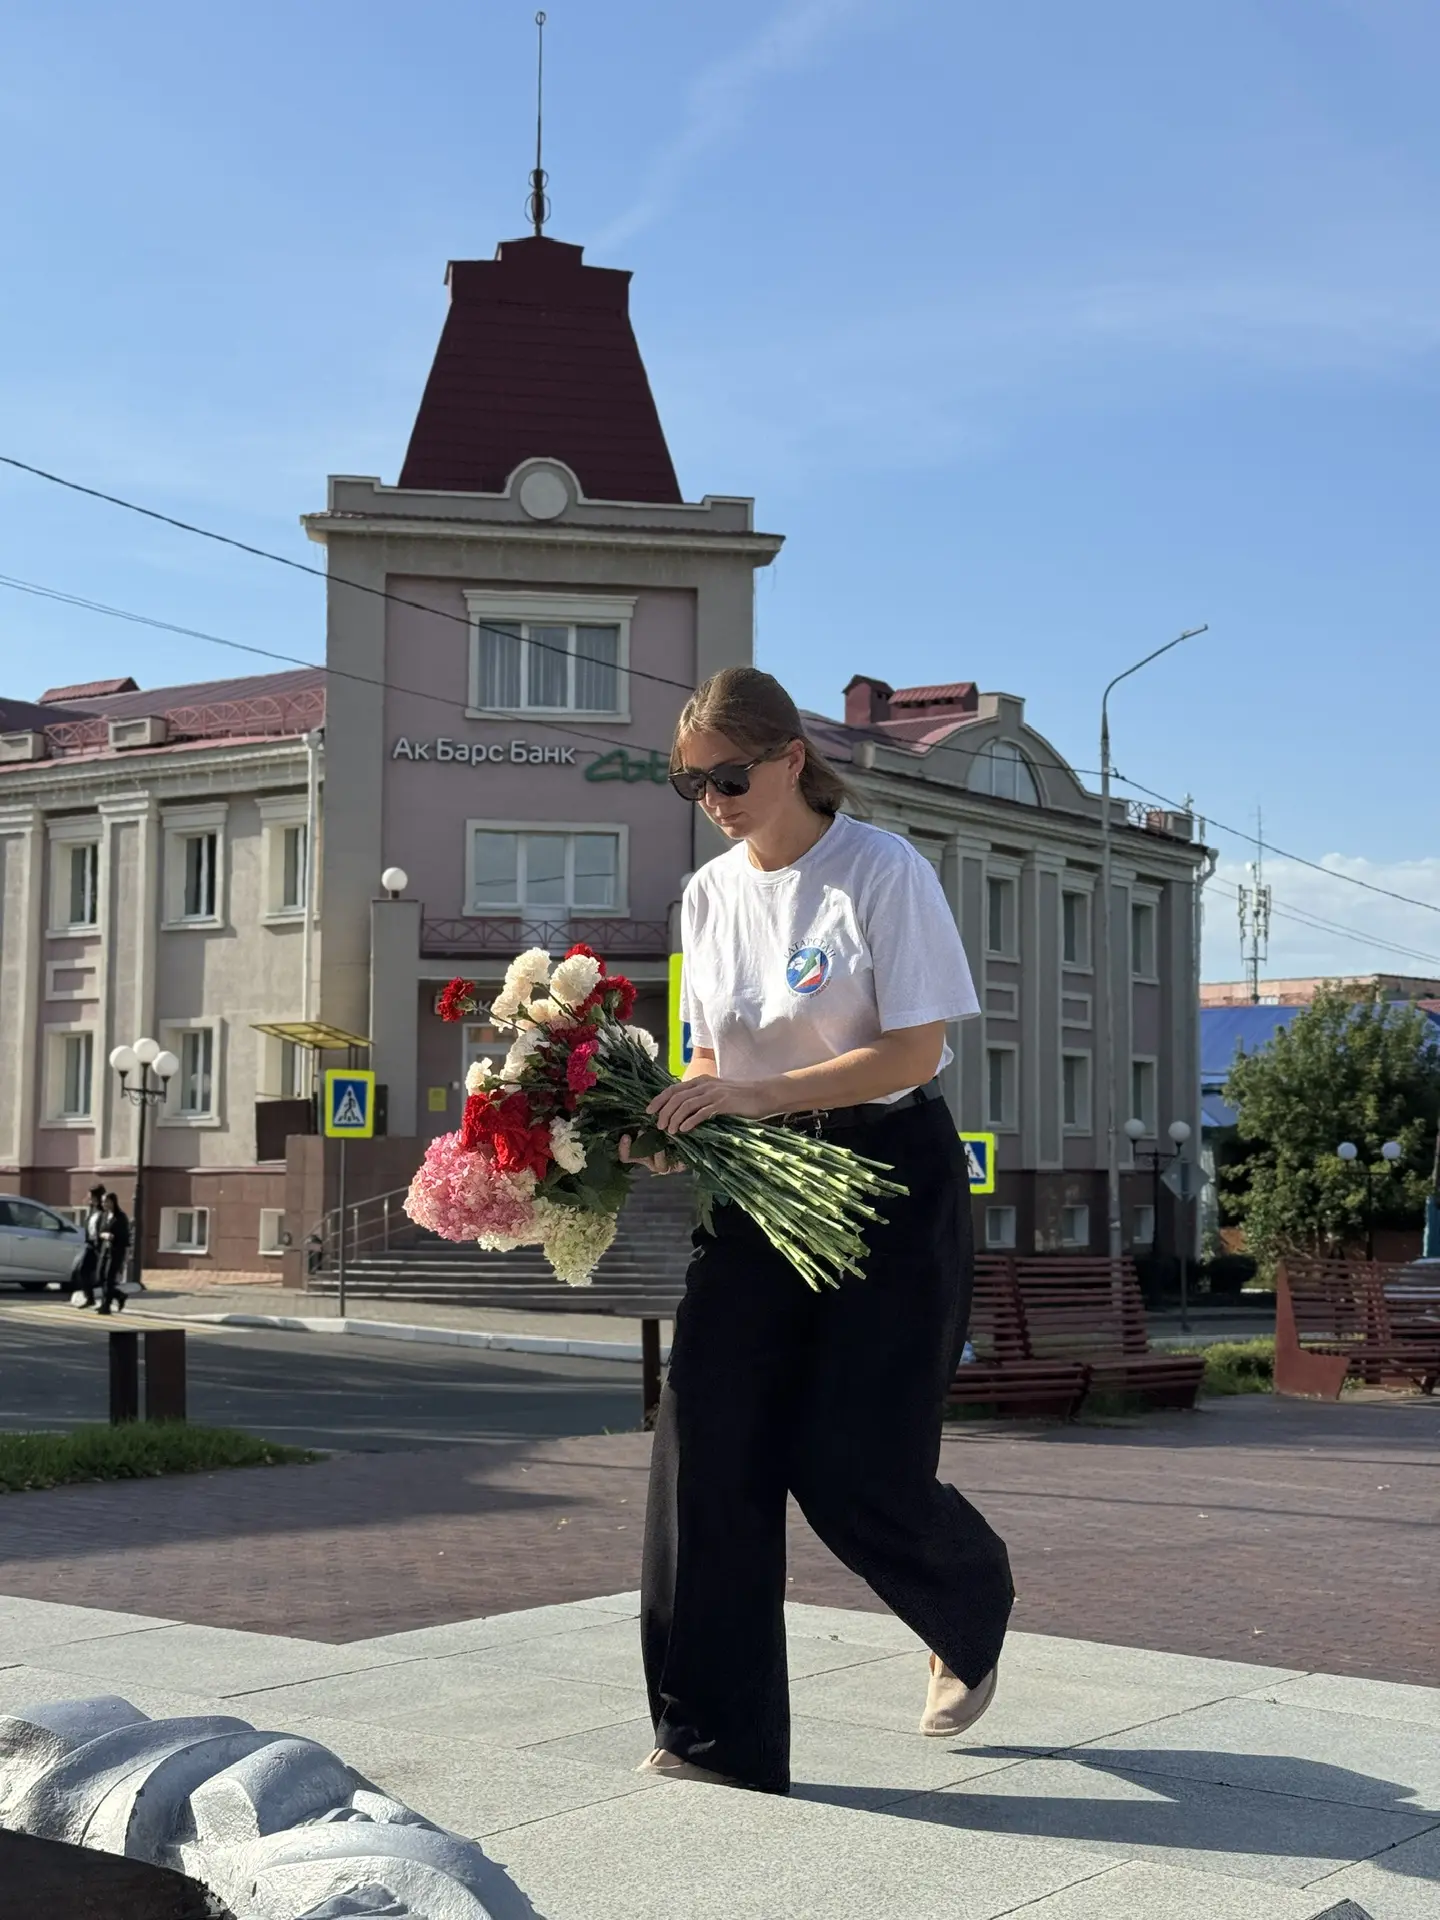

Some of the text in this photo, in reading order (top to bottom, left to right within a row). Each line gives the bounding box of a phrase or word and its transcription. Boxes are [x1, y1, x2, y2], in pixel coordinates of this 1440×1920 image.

[392, 737, 576, 766] Ак Барс Банк
